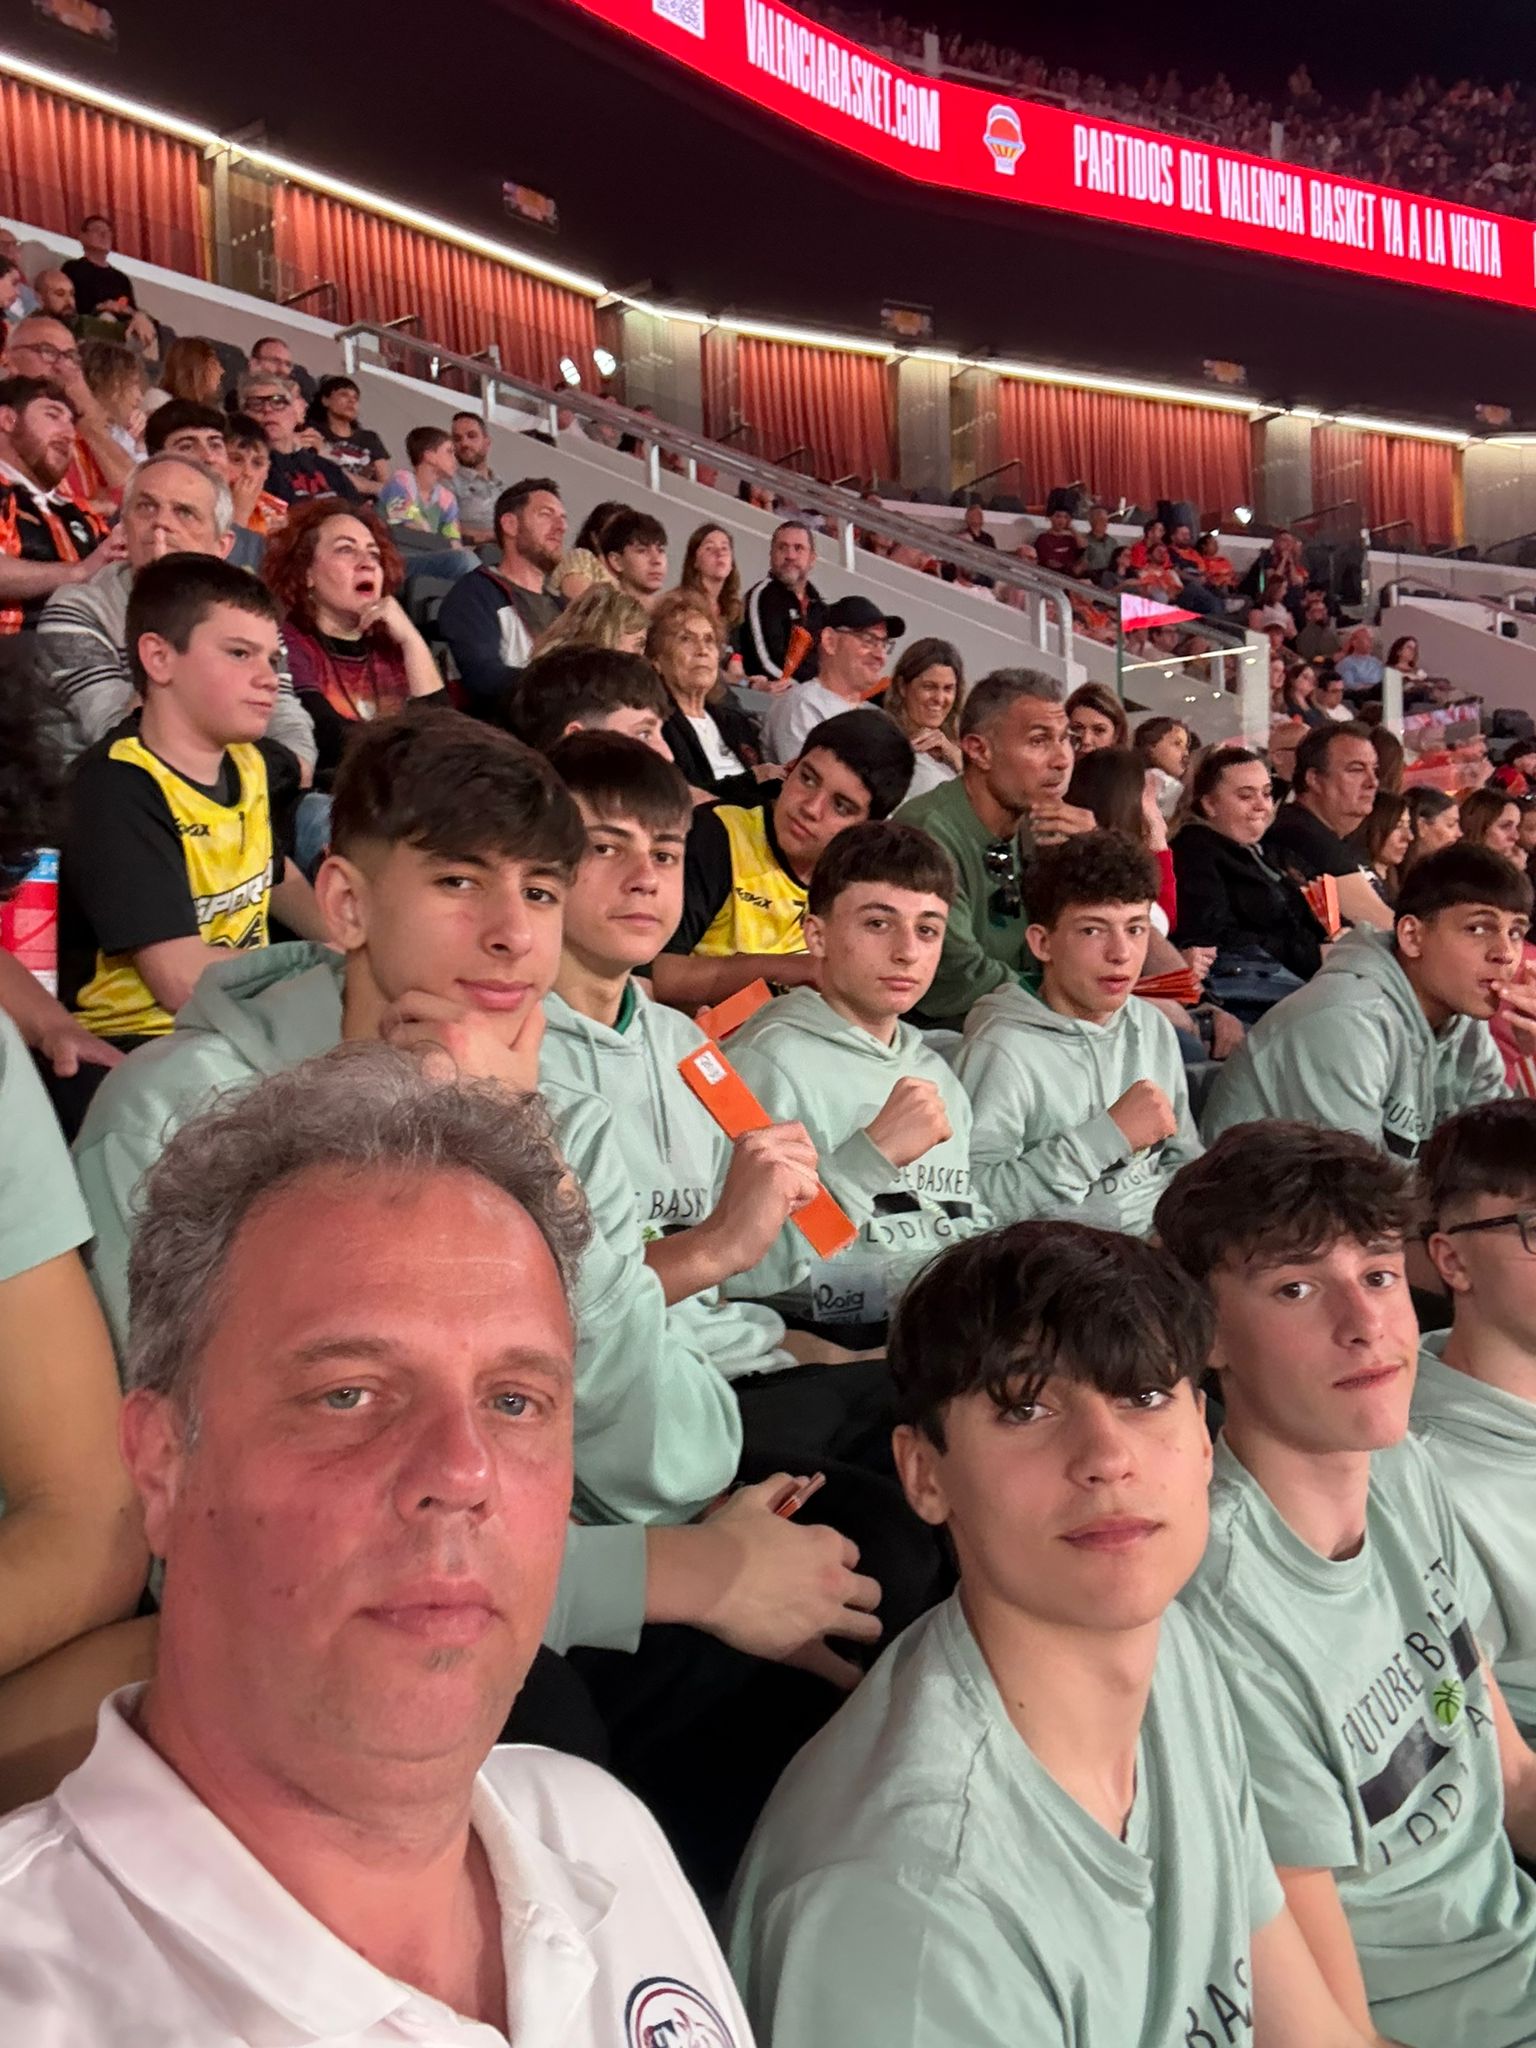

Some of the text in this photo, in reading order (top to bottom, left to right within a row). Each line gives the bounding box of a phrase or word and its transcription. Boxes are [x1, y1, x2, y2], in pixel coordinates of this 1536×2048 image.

[744, 0, 940, 152] VALENCIABASKET.COM
[1073, 123, 1502, 278] PARTIDOS DEL VALENCIA BASKET YA A LA VENTA
[1342, 1652, 1424, 1768] FUTURE
